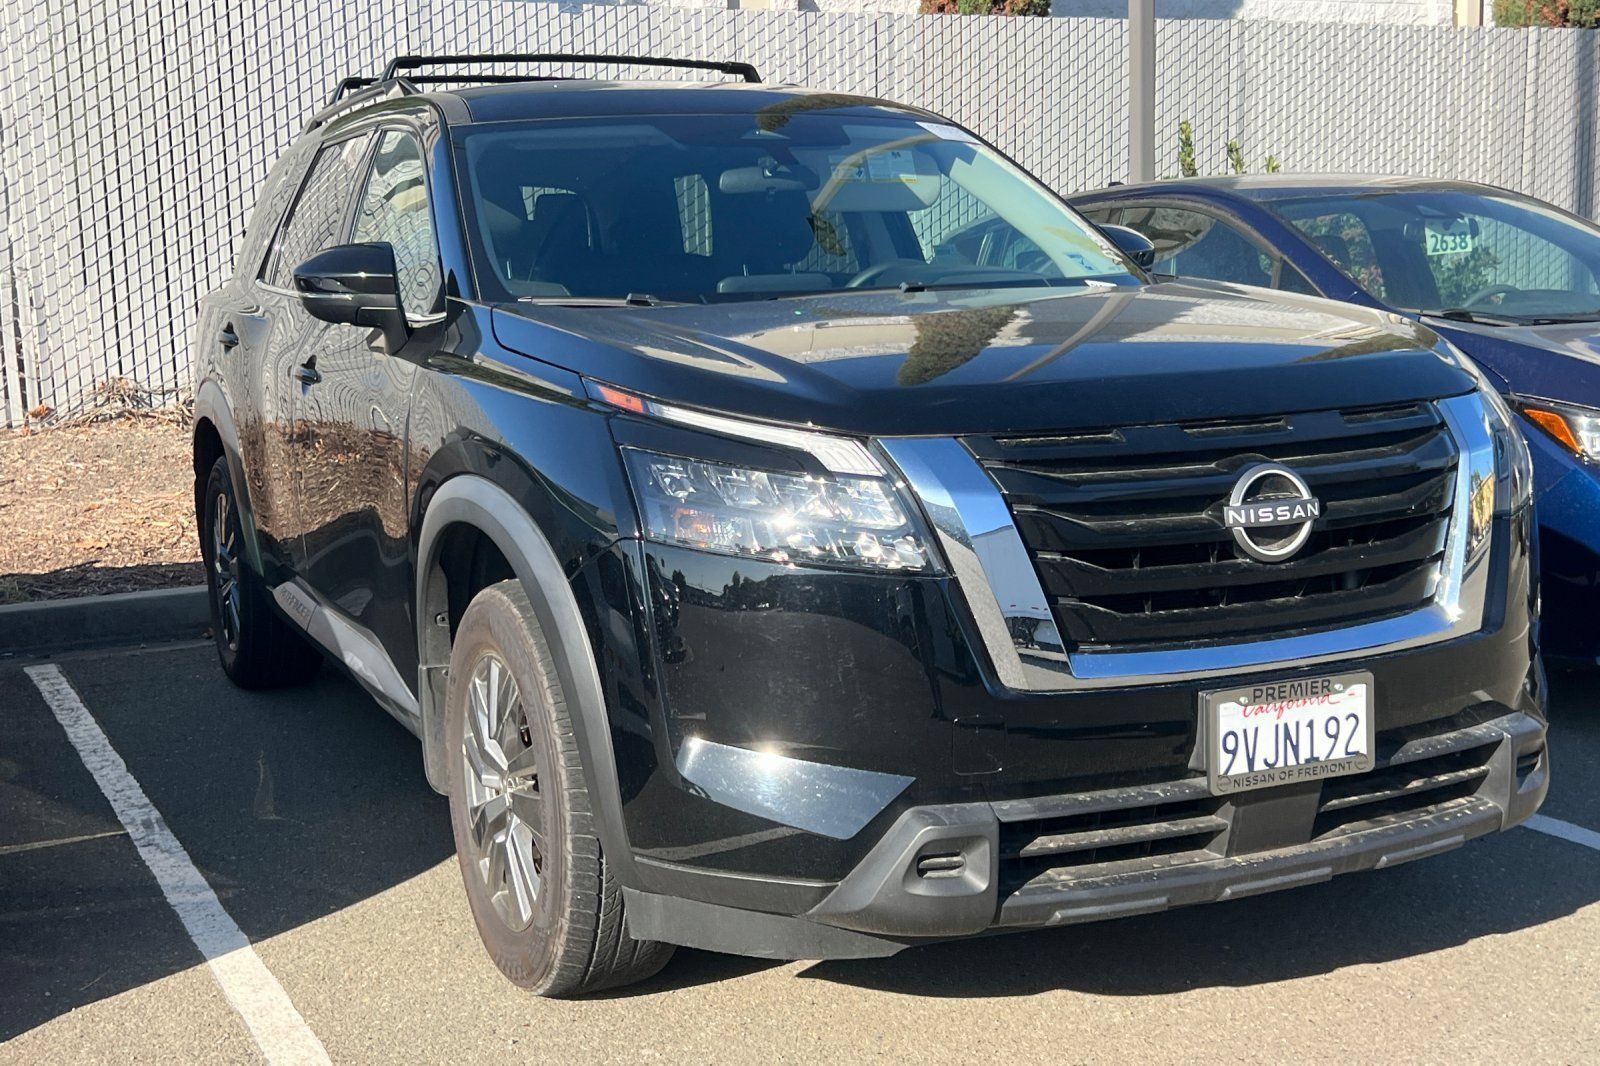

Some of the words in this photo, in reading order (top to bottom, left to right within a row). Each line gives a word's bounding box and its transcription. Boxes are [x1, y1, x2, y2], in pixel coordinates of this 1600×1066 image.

[1430, 232, 1468, 253] 2638
[1228, 502, 1319, 524] NISSAN
[1253, 679, 1332, 703] PREMIER
[1222, 713, 1360, 776] 9VJN192
[1233, 773, 1275, 788] NISSAN
[1279, 769, 1294, 781] OF
[1297, 760, 1353, 778] FREMONT
